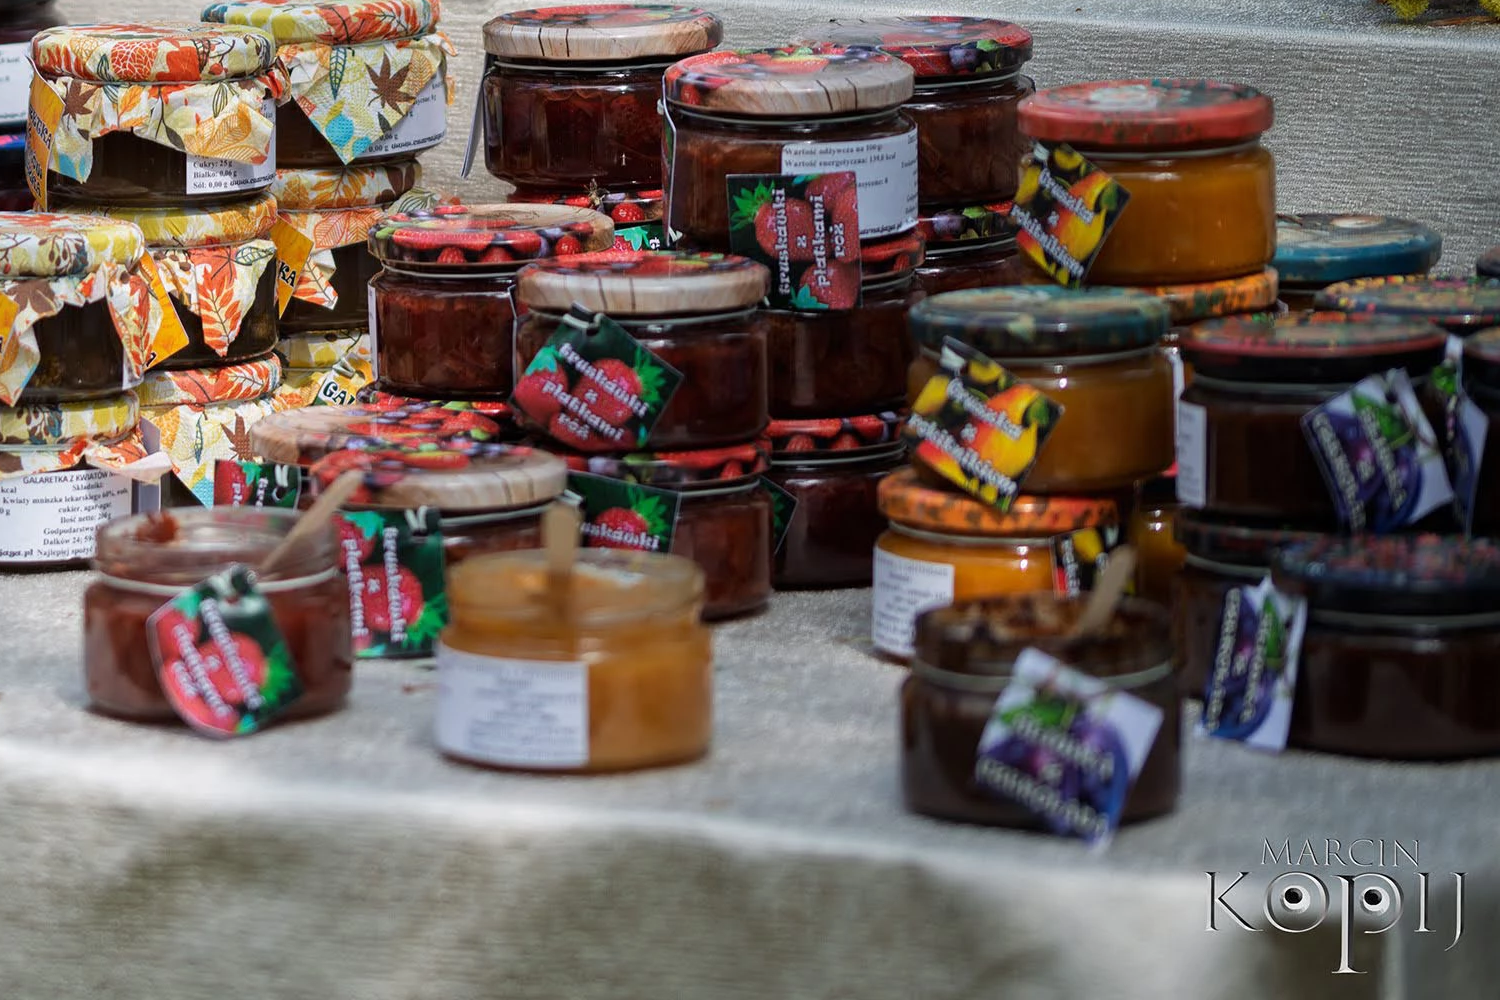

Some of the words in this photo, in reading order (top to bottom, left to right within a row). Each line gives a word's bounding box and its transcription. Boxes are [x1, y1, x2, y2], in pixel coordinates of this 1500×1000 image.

[193, 160, 217, 169] Cukry:
[772, 187, 789, 293] truskawki
[796, 235, 807, 247] z
[23, 476, 68, 484] GALARETKA
